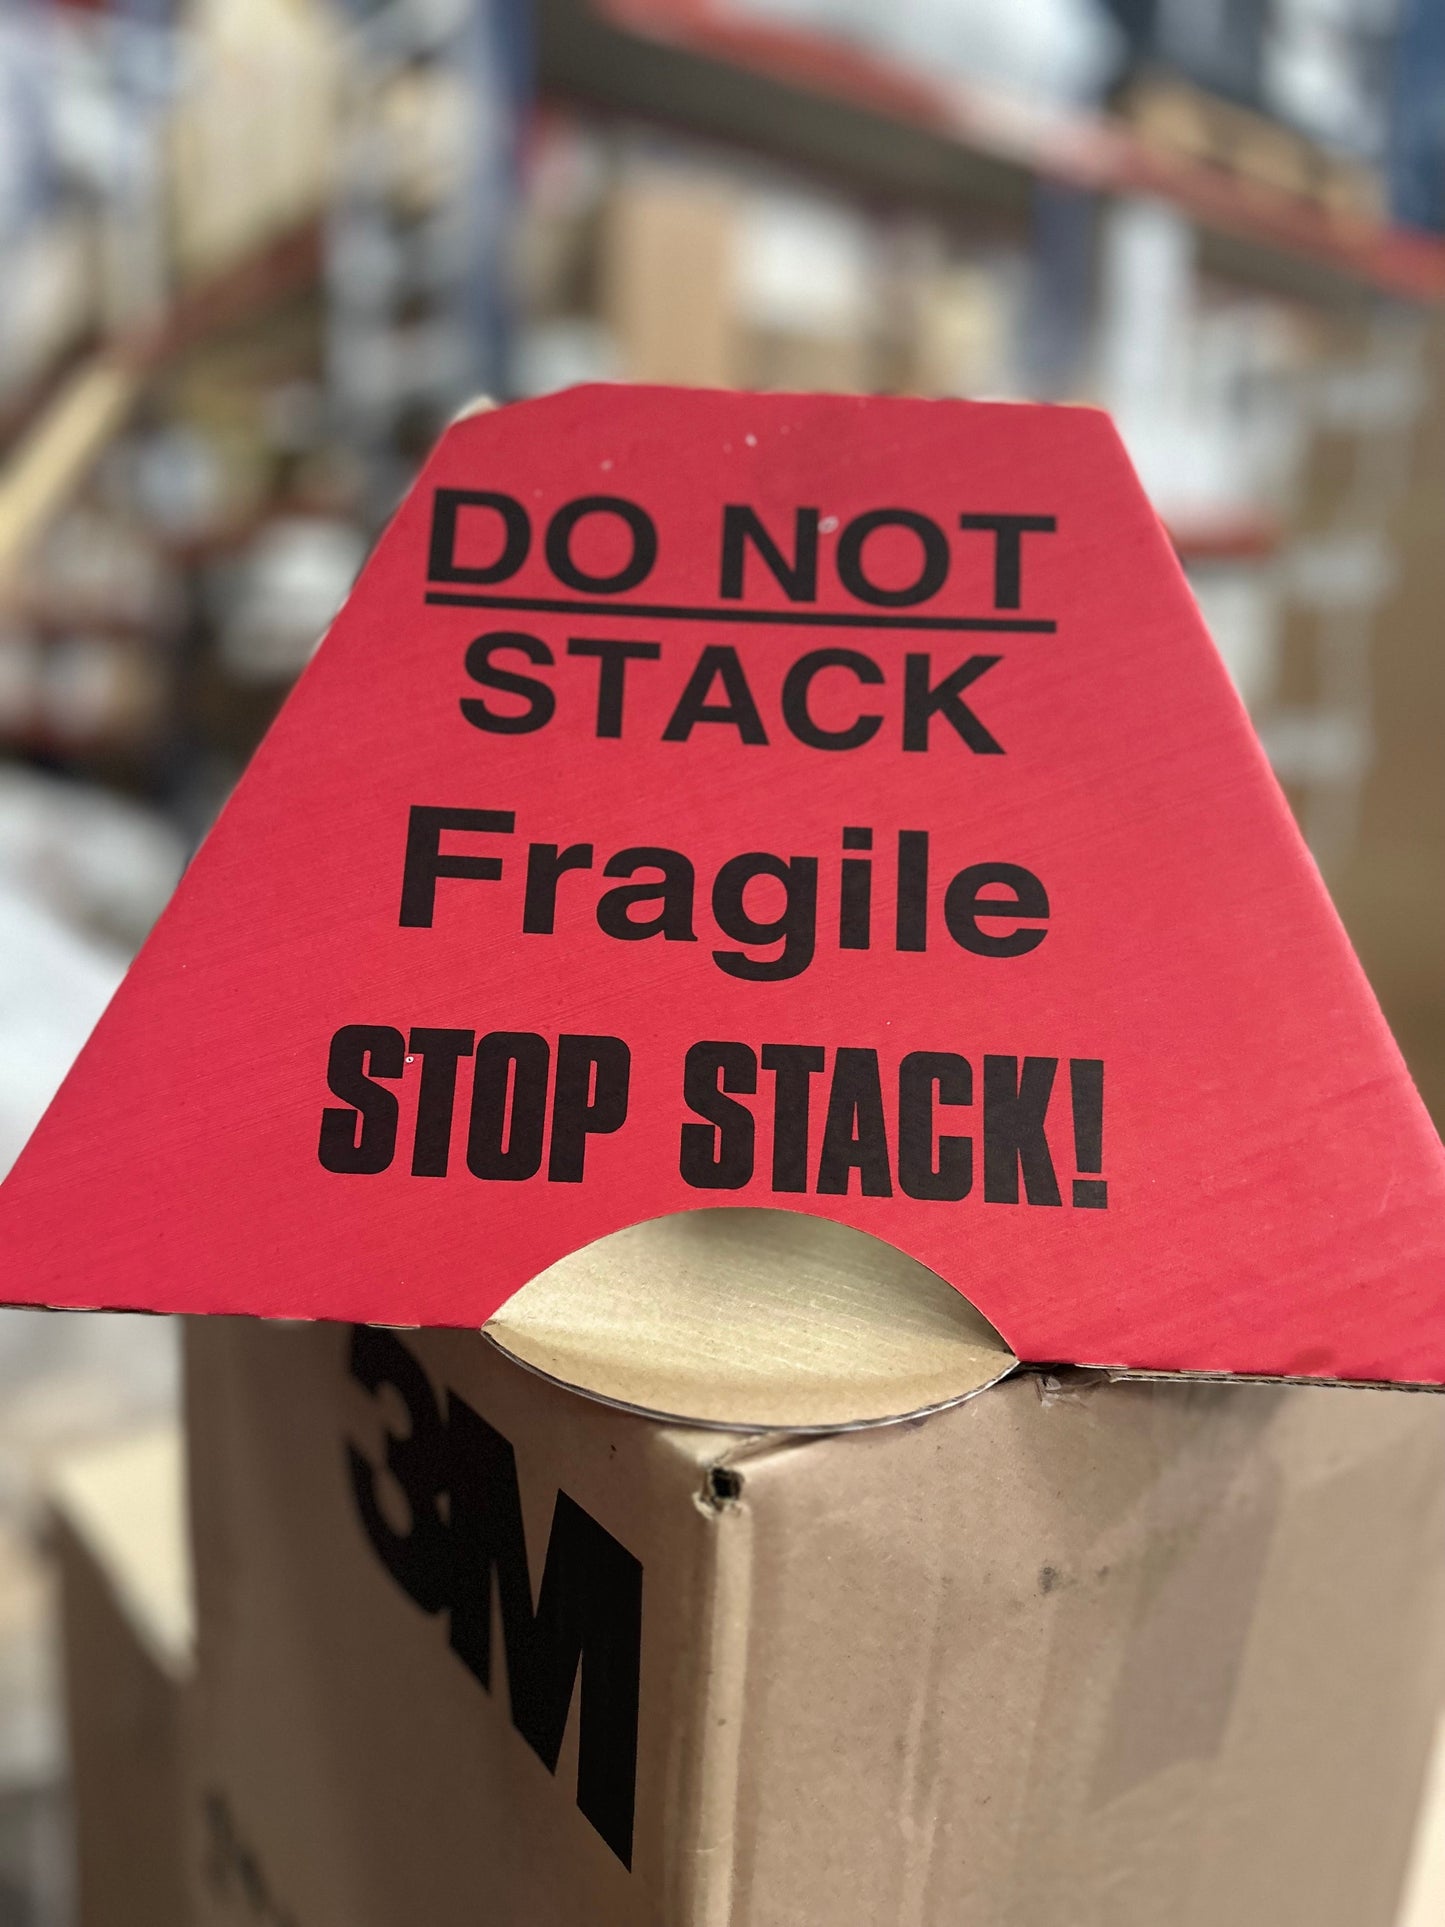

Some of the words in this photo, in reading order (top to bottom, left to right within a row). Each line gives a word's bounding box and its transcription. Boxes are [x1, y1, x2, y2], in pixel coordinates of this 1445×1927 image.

[427, 488, 657, 595] DO
[720, 505, 1057, 610] NOT
[461, 632, 1006, 755] STACK
[399, 805, 1051, 982] Fragile
[318, 1024, 631, 1184] STOP
[680, 1040, 1108, 1209] STACK!
[346, 1323, 643, 1873] 3M
